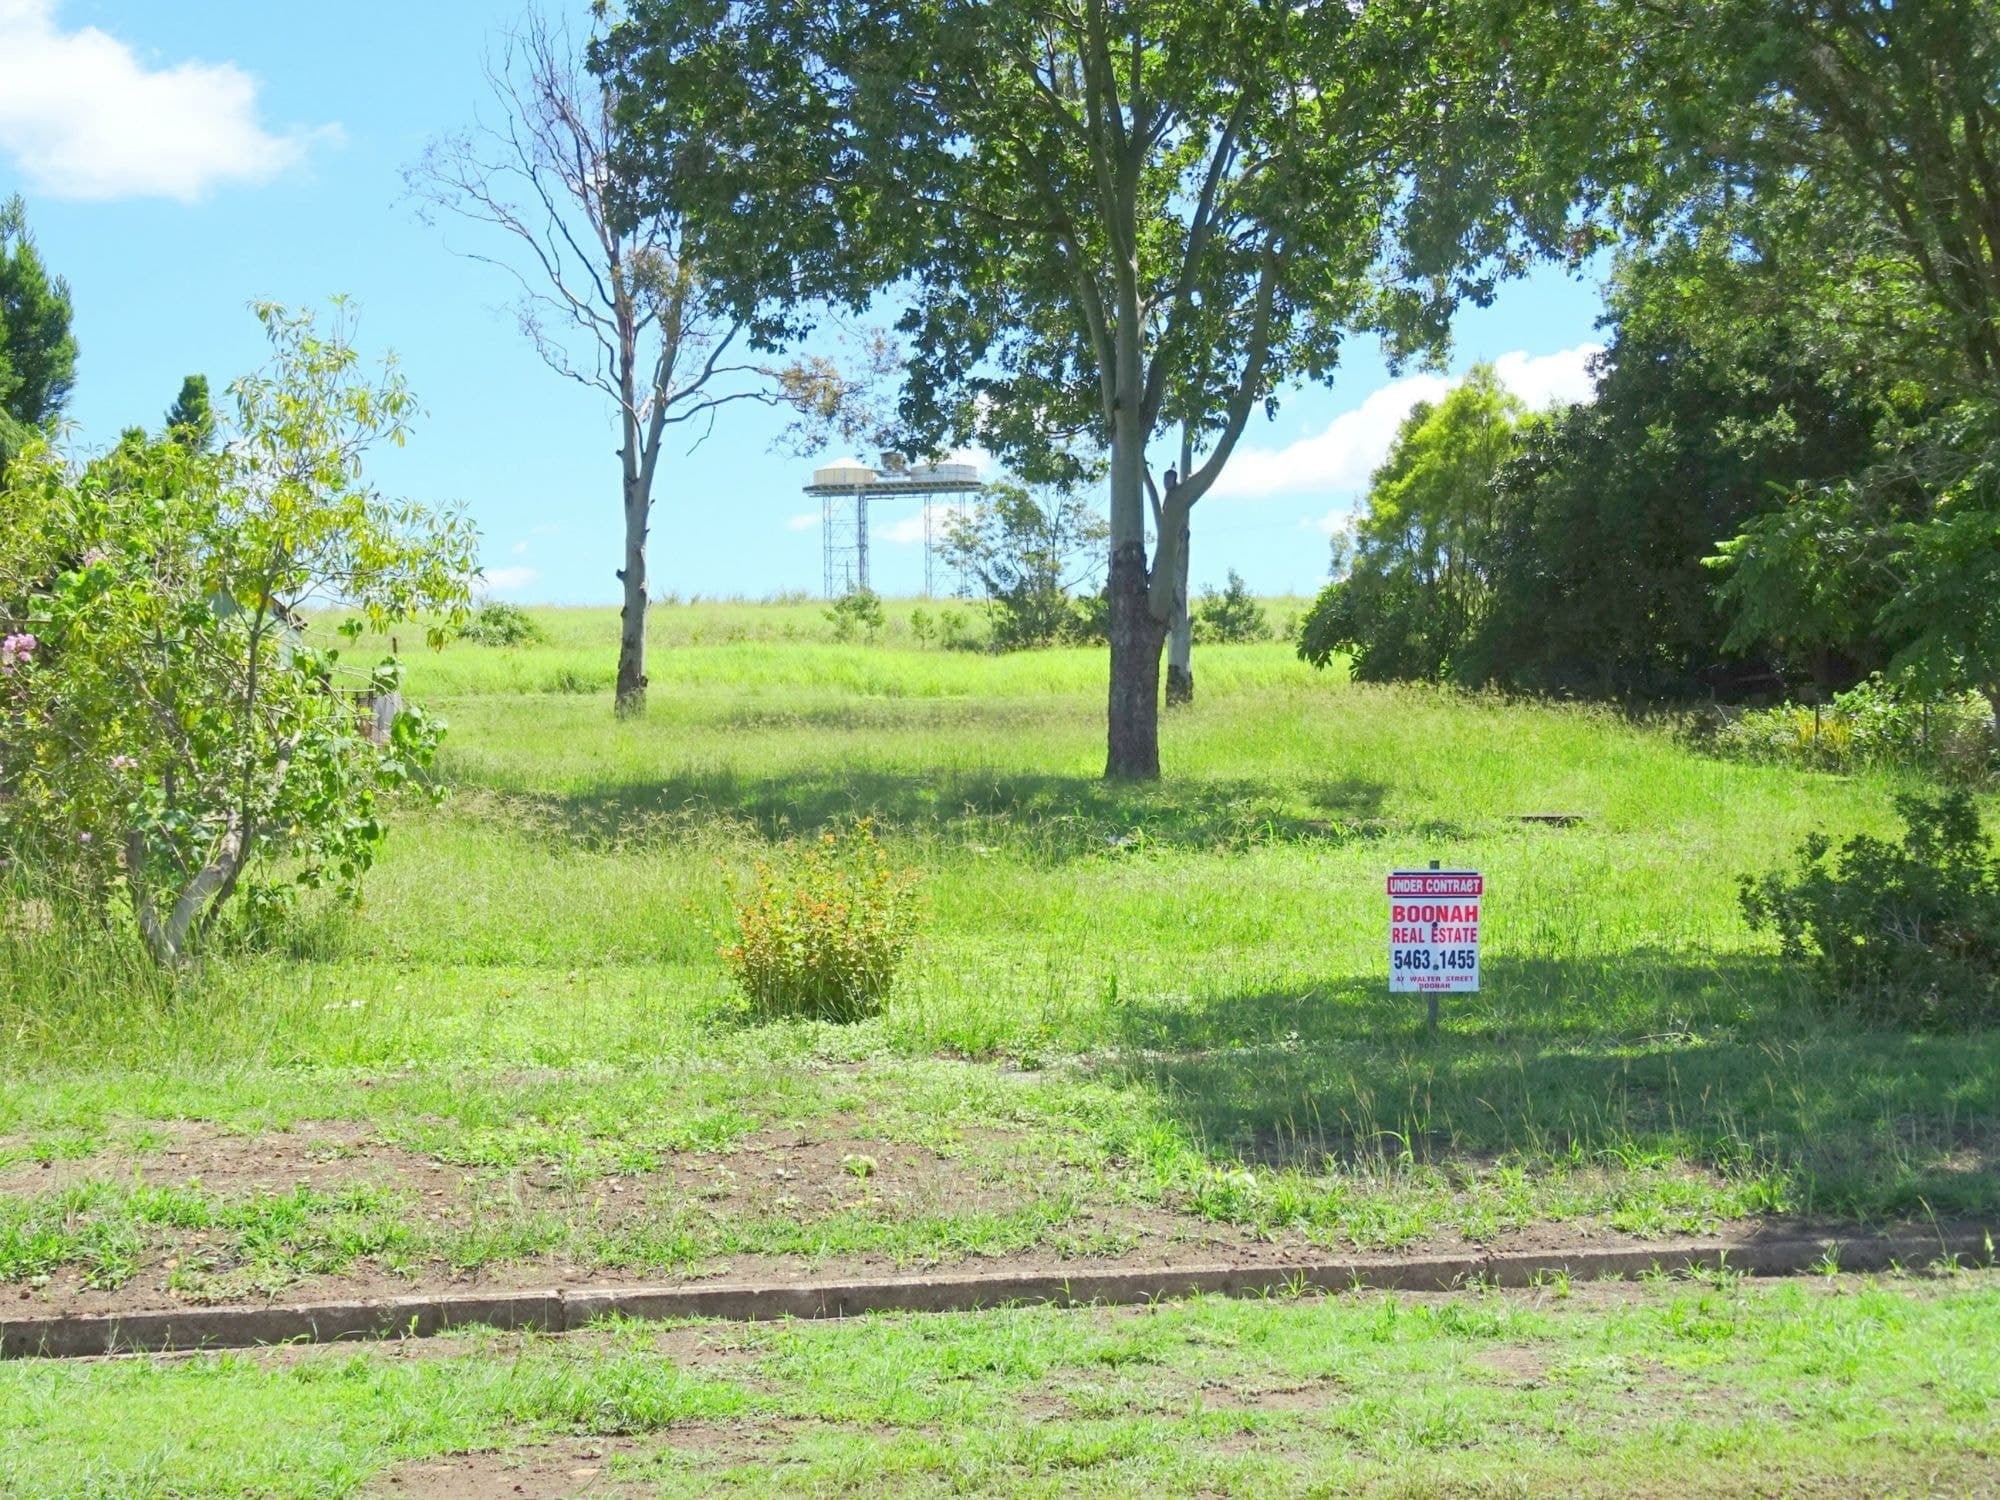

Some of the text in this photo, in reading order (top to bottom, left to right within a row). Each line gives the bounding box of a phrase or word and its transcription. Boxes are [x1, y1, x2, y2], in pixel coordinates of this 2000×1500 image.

[1390, 879, 1480, 892] UNDER CONTRACT
[1392, 905, 1478, 922] BOONAH
[1392, 927, 1477, 943] REAL ESTATE
